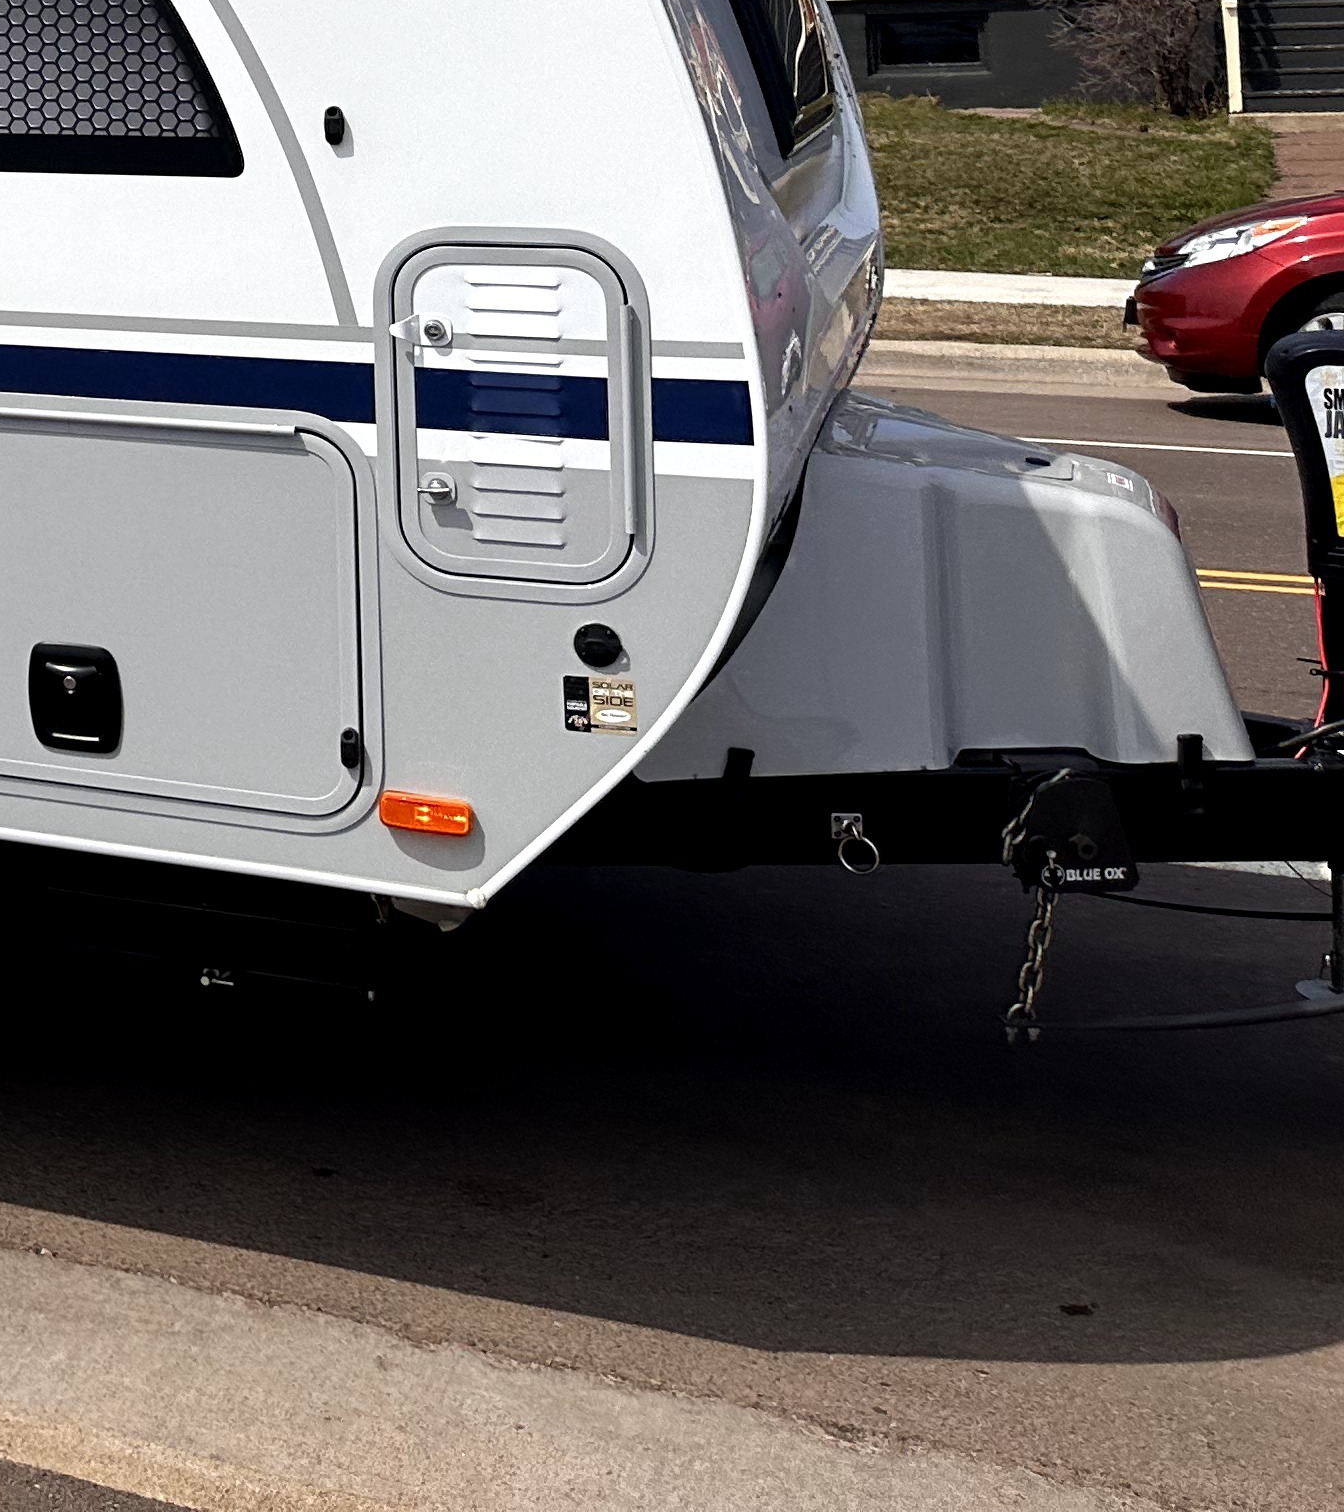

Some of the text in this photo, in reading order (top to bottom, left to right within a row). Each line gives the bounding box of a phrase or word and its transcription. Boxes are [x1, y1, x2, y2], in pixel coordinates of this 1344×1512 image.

[592, 681, 634, 691] SOLAR
[592, 694, 634, 707] SIDE
[1066, 867, 1126, 881] BLUE OX
